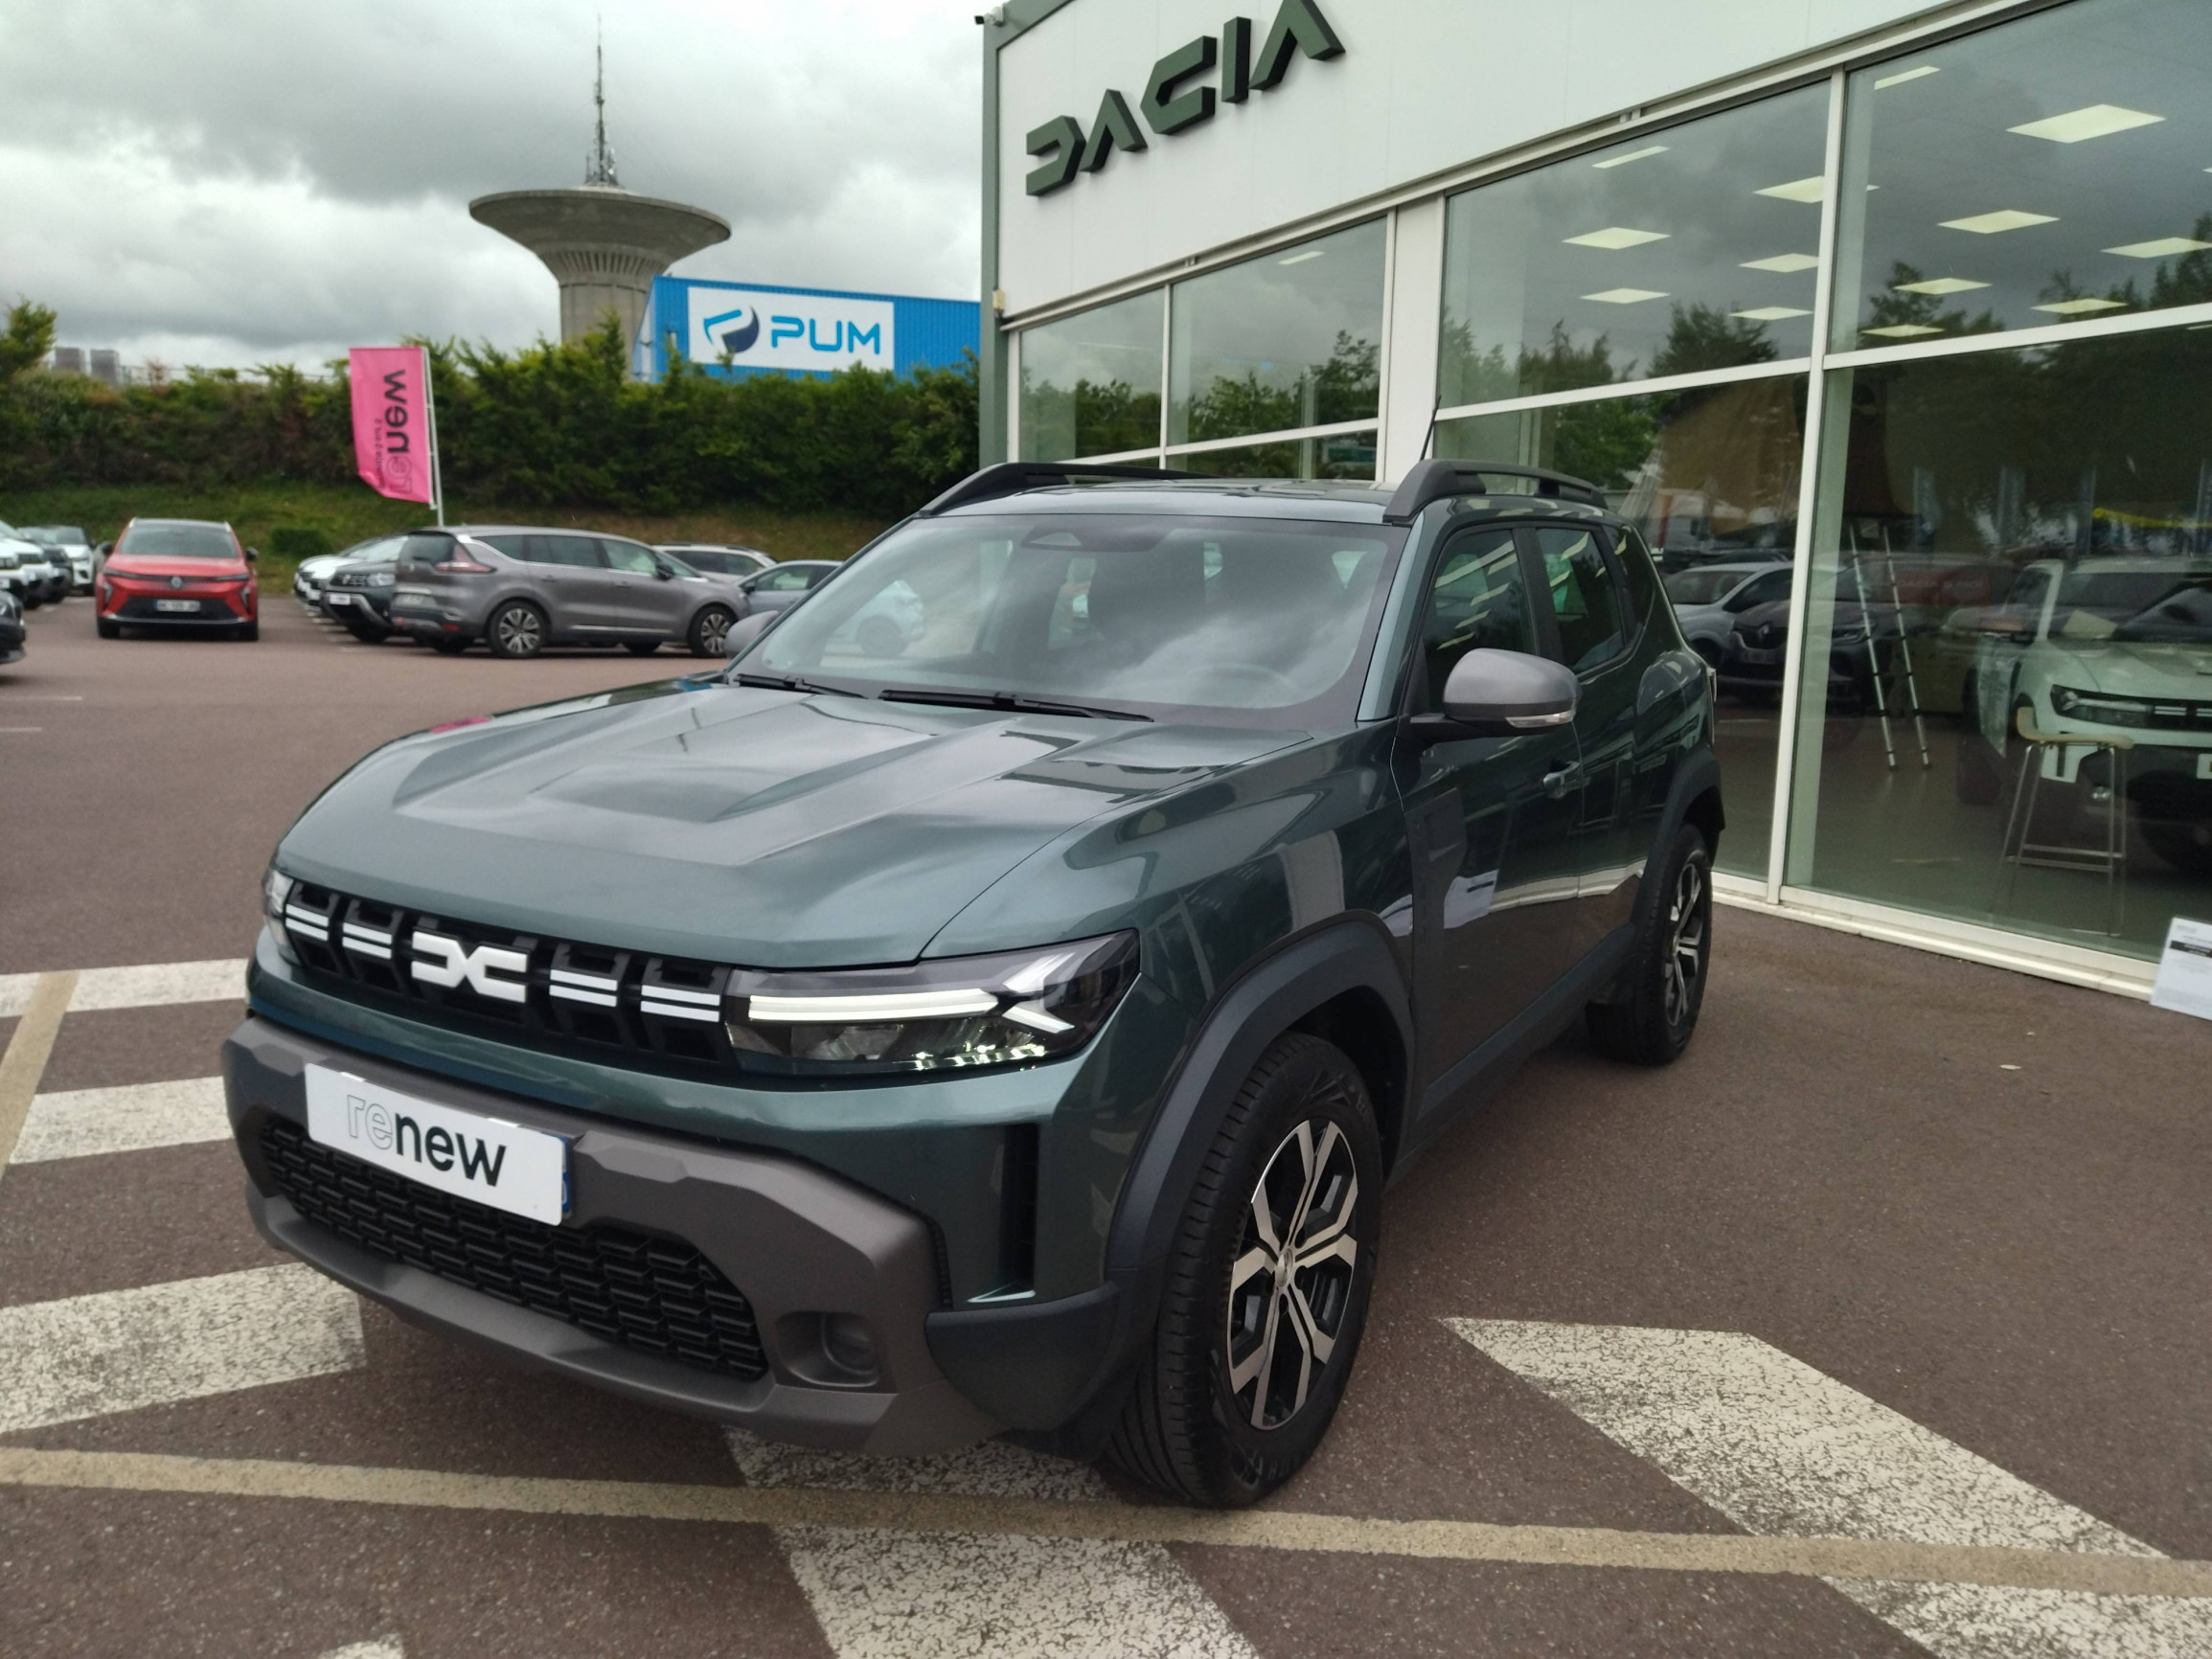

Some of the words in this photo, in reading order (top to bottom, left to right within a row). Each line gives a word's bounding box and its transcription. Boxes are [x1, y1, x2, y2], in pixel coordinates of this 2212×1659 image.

[1026, 0, 1346, 195] DACIA
[771, 315, 880, 354] PUM
[347, 1094, 507, 1188] renew
